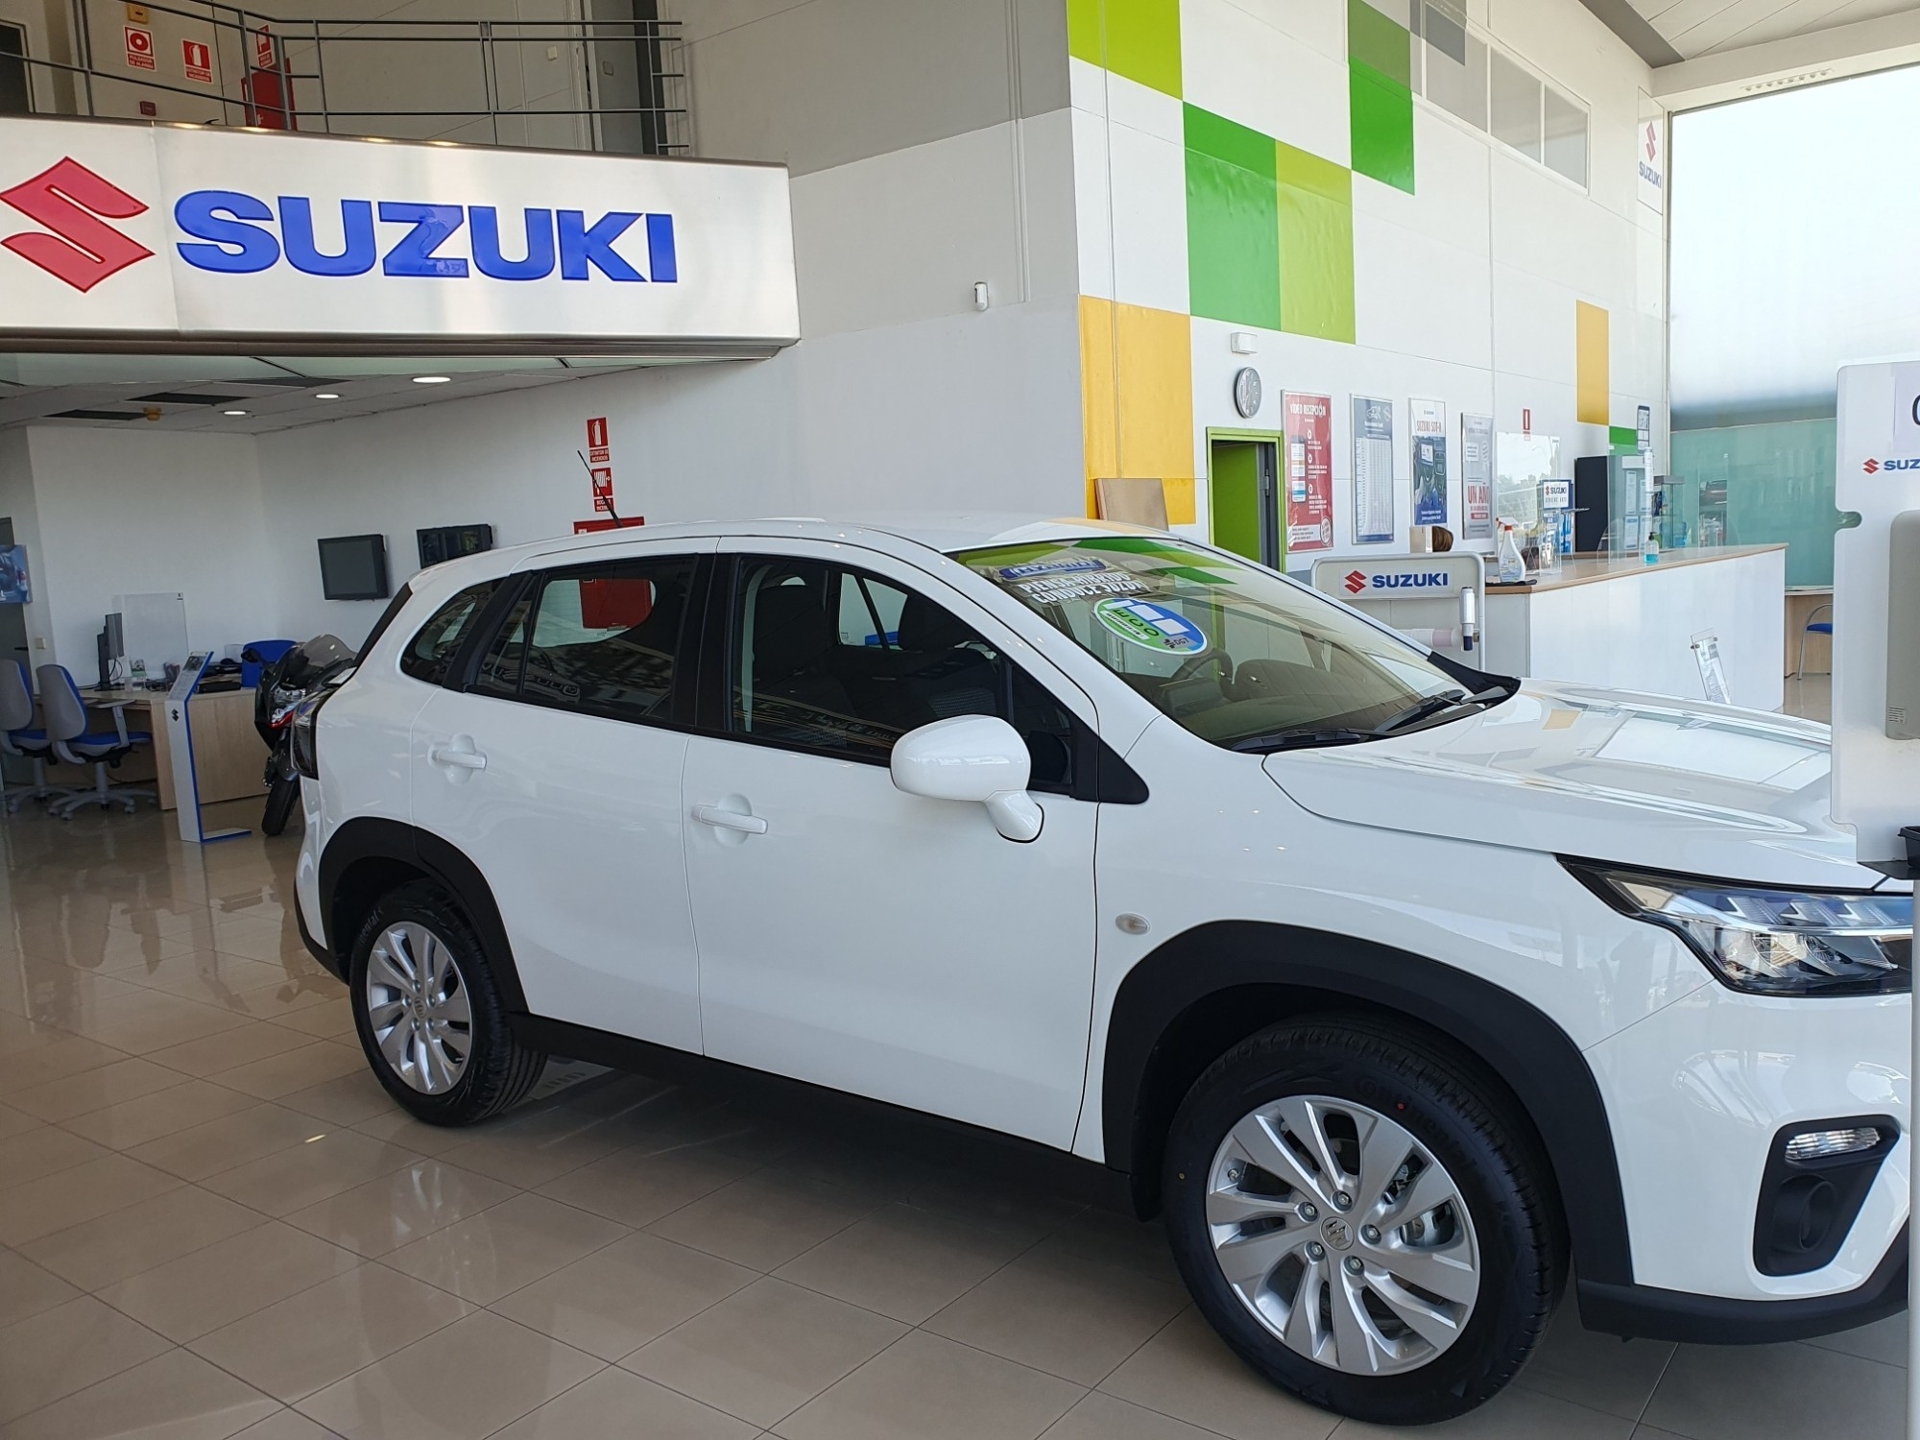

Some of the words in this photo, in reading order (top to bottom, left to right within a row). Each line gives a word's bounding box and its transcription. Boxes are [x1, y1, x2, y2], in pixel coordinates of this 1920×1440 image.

[1639, 161, 1662, 189] SUZUKI
[174, 190, 678, 283] SUZUKI
[1884, 459, 1920, 470] SUZ
[1372, 573, 1449, 588] SUZUKI
[1031, 584, 1102, 604] CONDUCE
[1112, 609, 1160, 637] ECO
